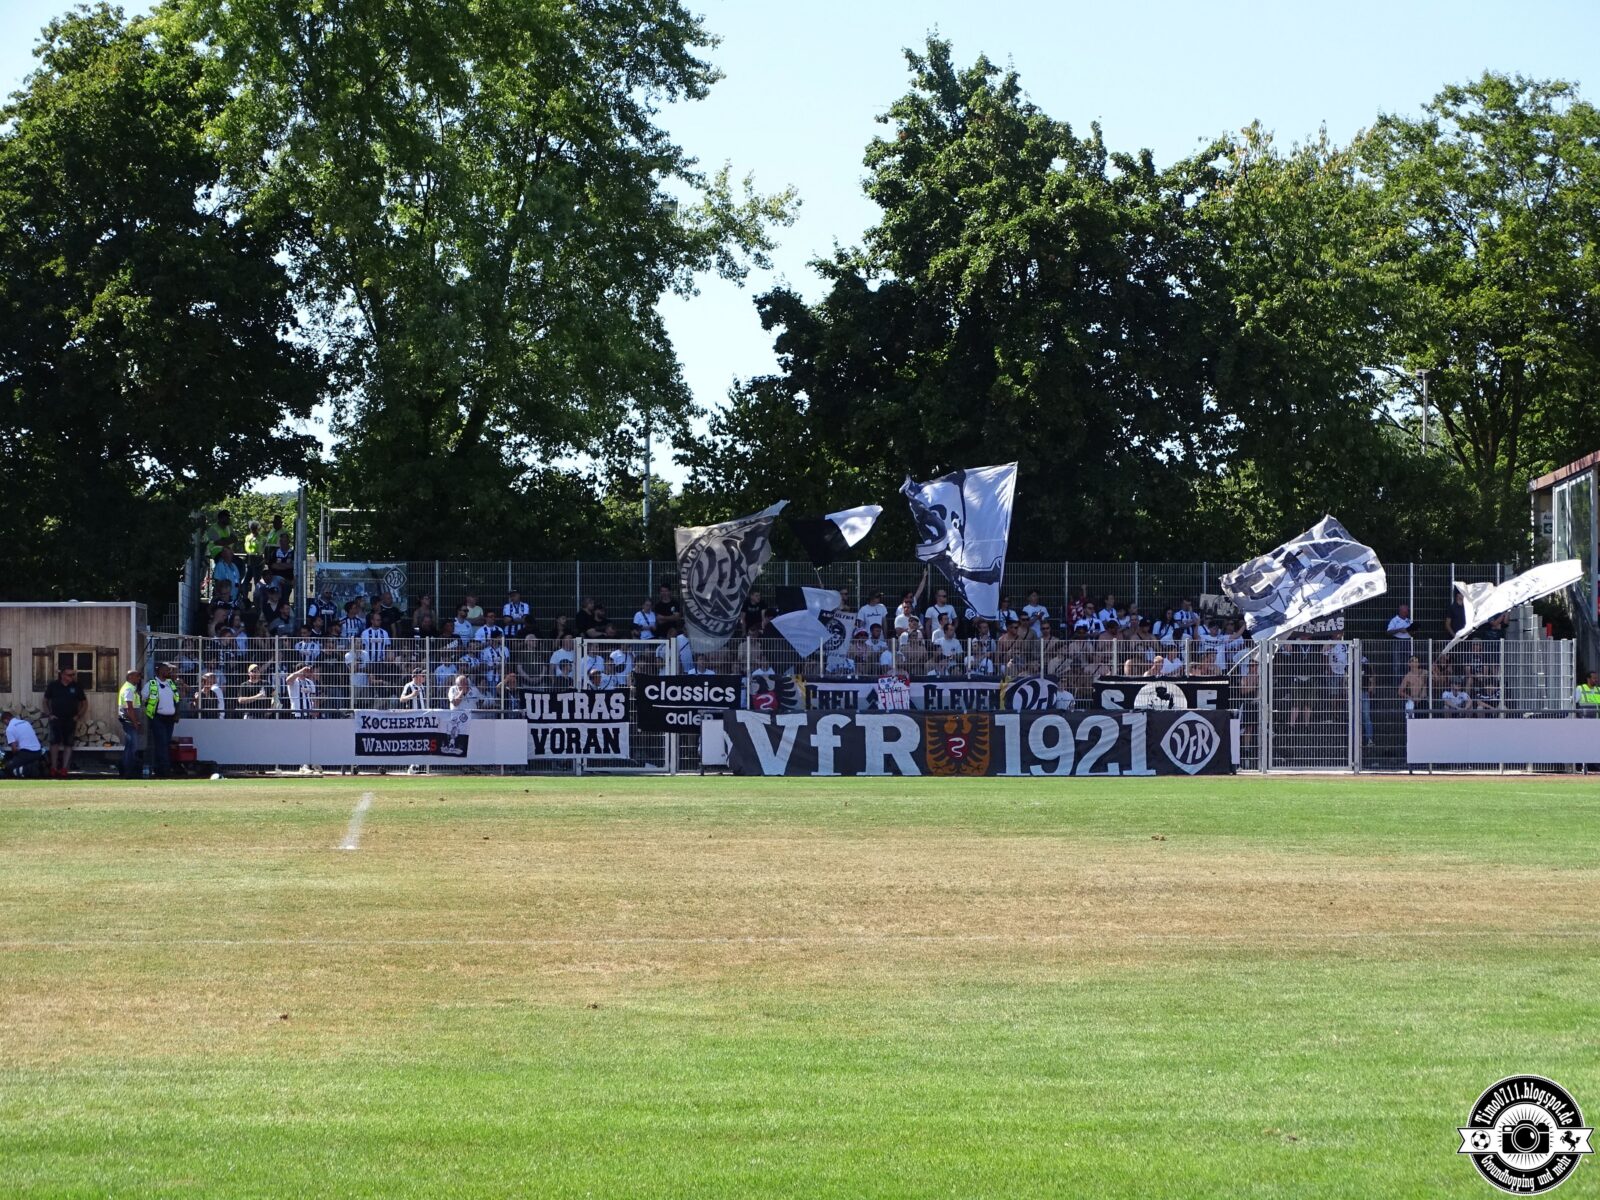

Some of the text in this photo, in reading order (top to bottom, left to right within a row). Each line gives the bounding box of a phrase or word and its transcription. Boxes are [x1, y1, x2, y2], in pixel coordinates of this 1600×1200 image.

[644, 681, 736, 702] classics
[524, 692, 625, 720] ULTRAS
[361, 715, 439, 729] KOCHERTAL
[362, 738, 437, 752] WANDERERS
[530, 727, 621, 755] VORAN
[736, 713, 1156, 776] VfR 1921
